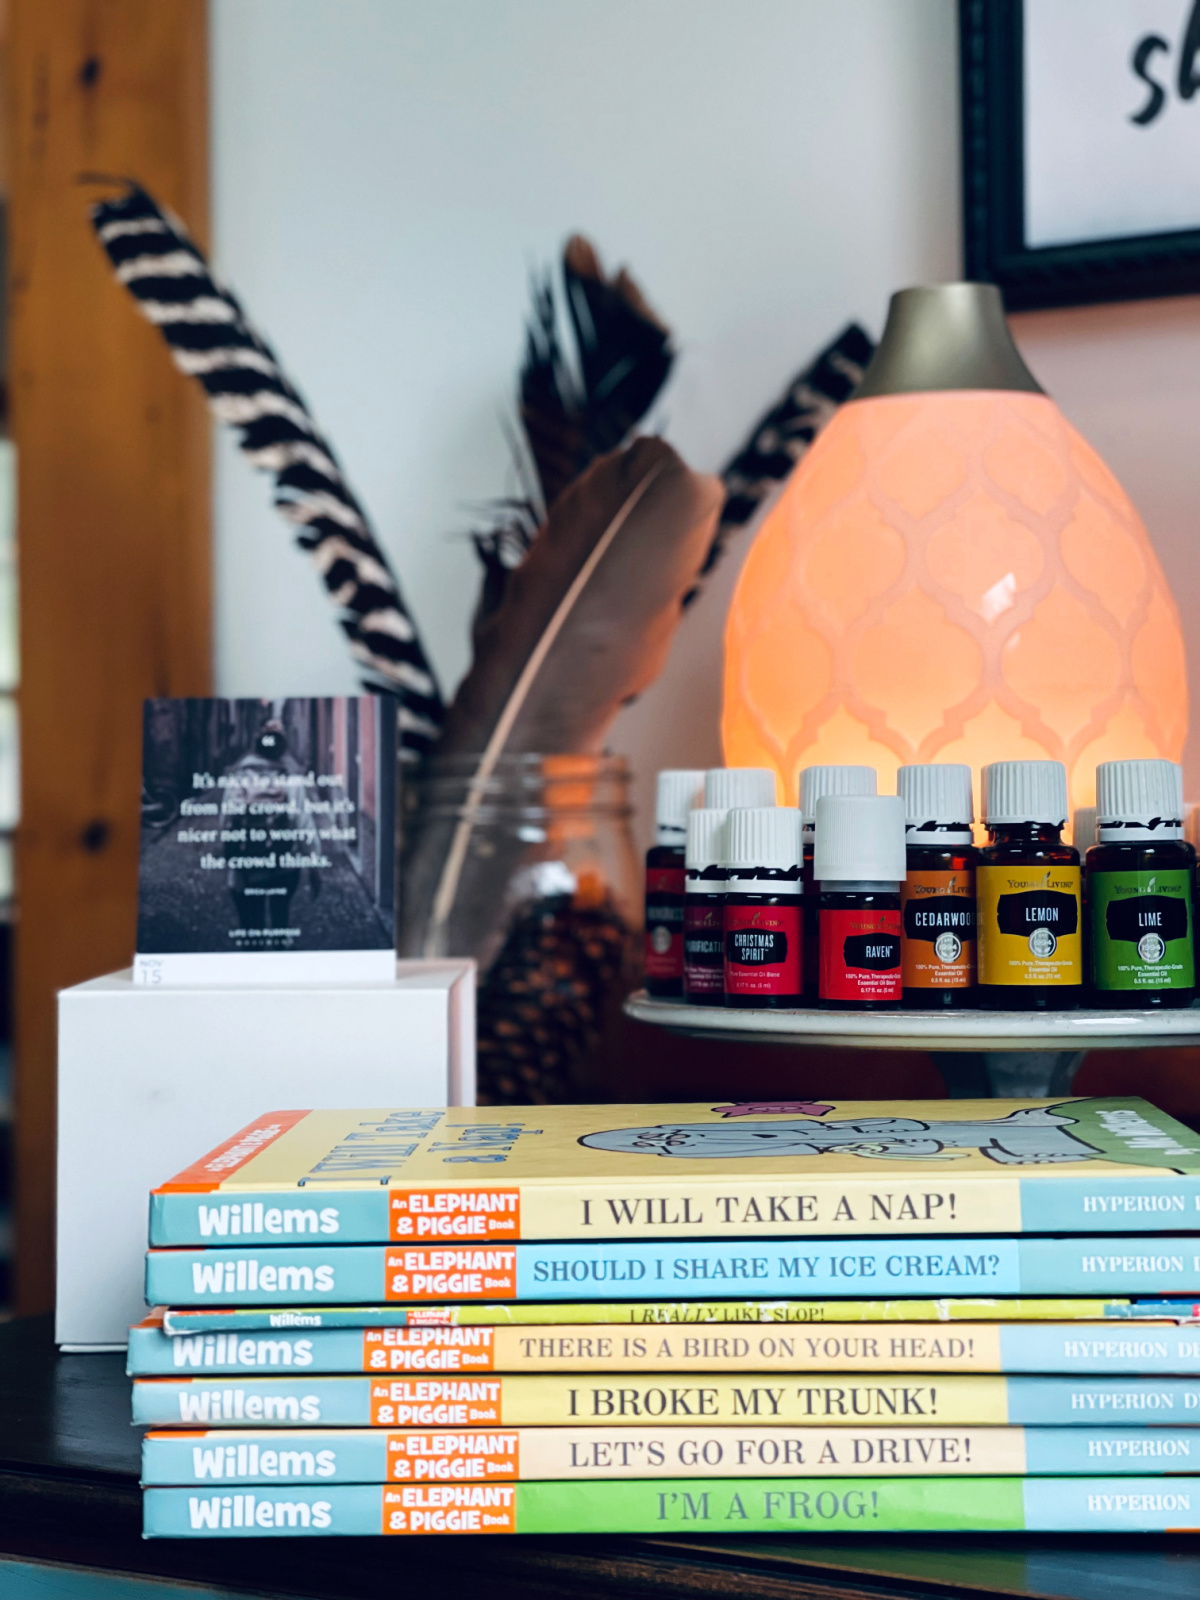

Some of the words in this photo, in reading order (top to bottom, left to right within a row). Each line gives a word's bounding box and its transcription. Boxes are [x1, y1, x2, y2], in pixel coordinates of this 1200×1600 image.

[192, 772, 215, 788] It's
[180, 799, 218, 815] from
[221, 801, 247, 814] the
[303, 800, 329, 814] but
[177, 827, 218, 842] nicer
[220, 828, 247, 842] not
[250, 828, 267, 842] to
[270, 829, 316, 845] worry
[319, 825, 356, 841] what
[201, 853, 225, 869] the
[228, 852, 276, 869] crowd
[279, 852, 332, 868] thinks.
[1025, 907, 1059, 921] LEMON
[1138, 912, 1162, 927] LIME
[734, 934, 774, 947] CHRISTMAS
[142, 969, 162, 985] 15
[343, 1111, 446, 1142] Take
[427, 1122, 544, 1152] Nap!
[309, 1143, 419, 1173] Will
[392, 1198, 408, 1209] An
[408, 1194, 518, 1214] ELEPHANT
[580, 1199, 593, 1226] I
[607, 1197, 703, 1225] WILL
[716, 1194, 818, 1223] TAKE
[832, 1194, 858, 1222] A
[870, 1192, 958, 1221] NAP!
[1083, 1195, 1185, 1212] HYPERION
[198, 1203, 340, 1236] Willems
[396, 1217, 414, 1236] &
[416, 1215, 487, 1236] PIGGIE
[489, 1218, 515, 1231] Book
[387, 1256, 403, 1267] An
[404, 1251, 515, 1270] ELEPHANT
[533, 1259, 645, 1282] SHOULD
[654, 1259, 665, 1280] I
[673, 1257, 769, 1280] SHARE
[778, 1256, 821, 1278] MY
[829, 1255, 876, 1278] ICE
[885, 1254, 1000, 1277] CREAM?
[1082, 1255, 1184, 1272] HYPERION
[192, 1259, 335, 1293] Willems
[391, 1275, 410, 1293] &
[412, 1273, 482, 1294] PIGGIE
[484, 1276, 511, 1289] Book
[269, 1313, 322, 1327] Willems
[629, 1309, 635, 1323] I
[642, 1307, 719, 1323] REALLY
[773, 1307, 825, 1322] SLOP!
[366, 1331, 382, 1342] An
[382, 1328, 494, 1347] ELEPHANT
[520, 1337, 613, 1358] THERE
[623, 1337, 647, 1358] IS
[656, 1337, 674, 1358] A
[683, 1337, 750, 1358] BIRD
[759, 1337, 796, 1358] ON
[805, 1337, 880, 1358] YOUR
[888, 1336, 975, 1359] HEAD!
[172, 1335, 314, 1368] Willems
[370, 1349, 388, 1368] &
[390, 1348, 461, 1369] PIGGIE
[461, 1353, 489, 1366] Book
[1064, 1340, 1168, 1358] HYPERION
[373, 1386, 389, 1398] An
[389, 1381, 501, 1402] ELEPHANT
[567, 1389, 580, 1417] I
[590, 1387, 720, 1416] BROKE
[731, 1387, 786, 1416] MY
[797, 1386, 939, 1416] TRUNK!
[1071, 1392, 1174, 1409] HYPERION
[1184, 1392, 1200, 1409] D
[178, 1390, 321, 1422] Willems
[377, 1406, 395, 1424] &
[397, 1403, 467, 1424] PIGGIE
[469, 1407, 497, 1420] Book
[389, 1441, 405, 1452] An
[405, 1434, 518, 1455] ELEPHANT
[569, 1440, 666, 1468] LET'S
[678, 1439, 724, 1466] GO
[736, 1439, 805, 1466] FOR
[817, 1439, 840, 1465] A
[852, 1437, 972, 1464] DRIVE!
[1088, 1439, 1191, 1456] HYPERION
[192, 1445, 336, 1479] Willems
[394, 1459, 411, 1478] &
[414, 1457, 485, 1479] PIGGIE
[487, 1461, 514, 1474] Book
[385, 1491, 400, 1503] An
[401, 1487, 514, 1508] ELEPHANT
[656, 1491, 710, 1520] I'M
[724, 1491, 749, 1520] A
[763, 1490, 880, 1519] FROG!
[1088, 1494, 1190, 1511] HYPERION
[188, 1495, 332, 1530] Willems
[389, 1510, 407, 1529] &
[409, 1509, 480, 1530] PIGGIE
[482, 1513, 510, 1526] Book
